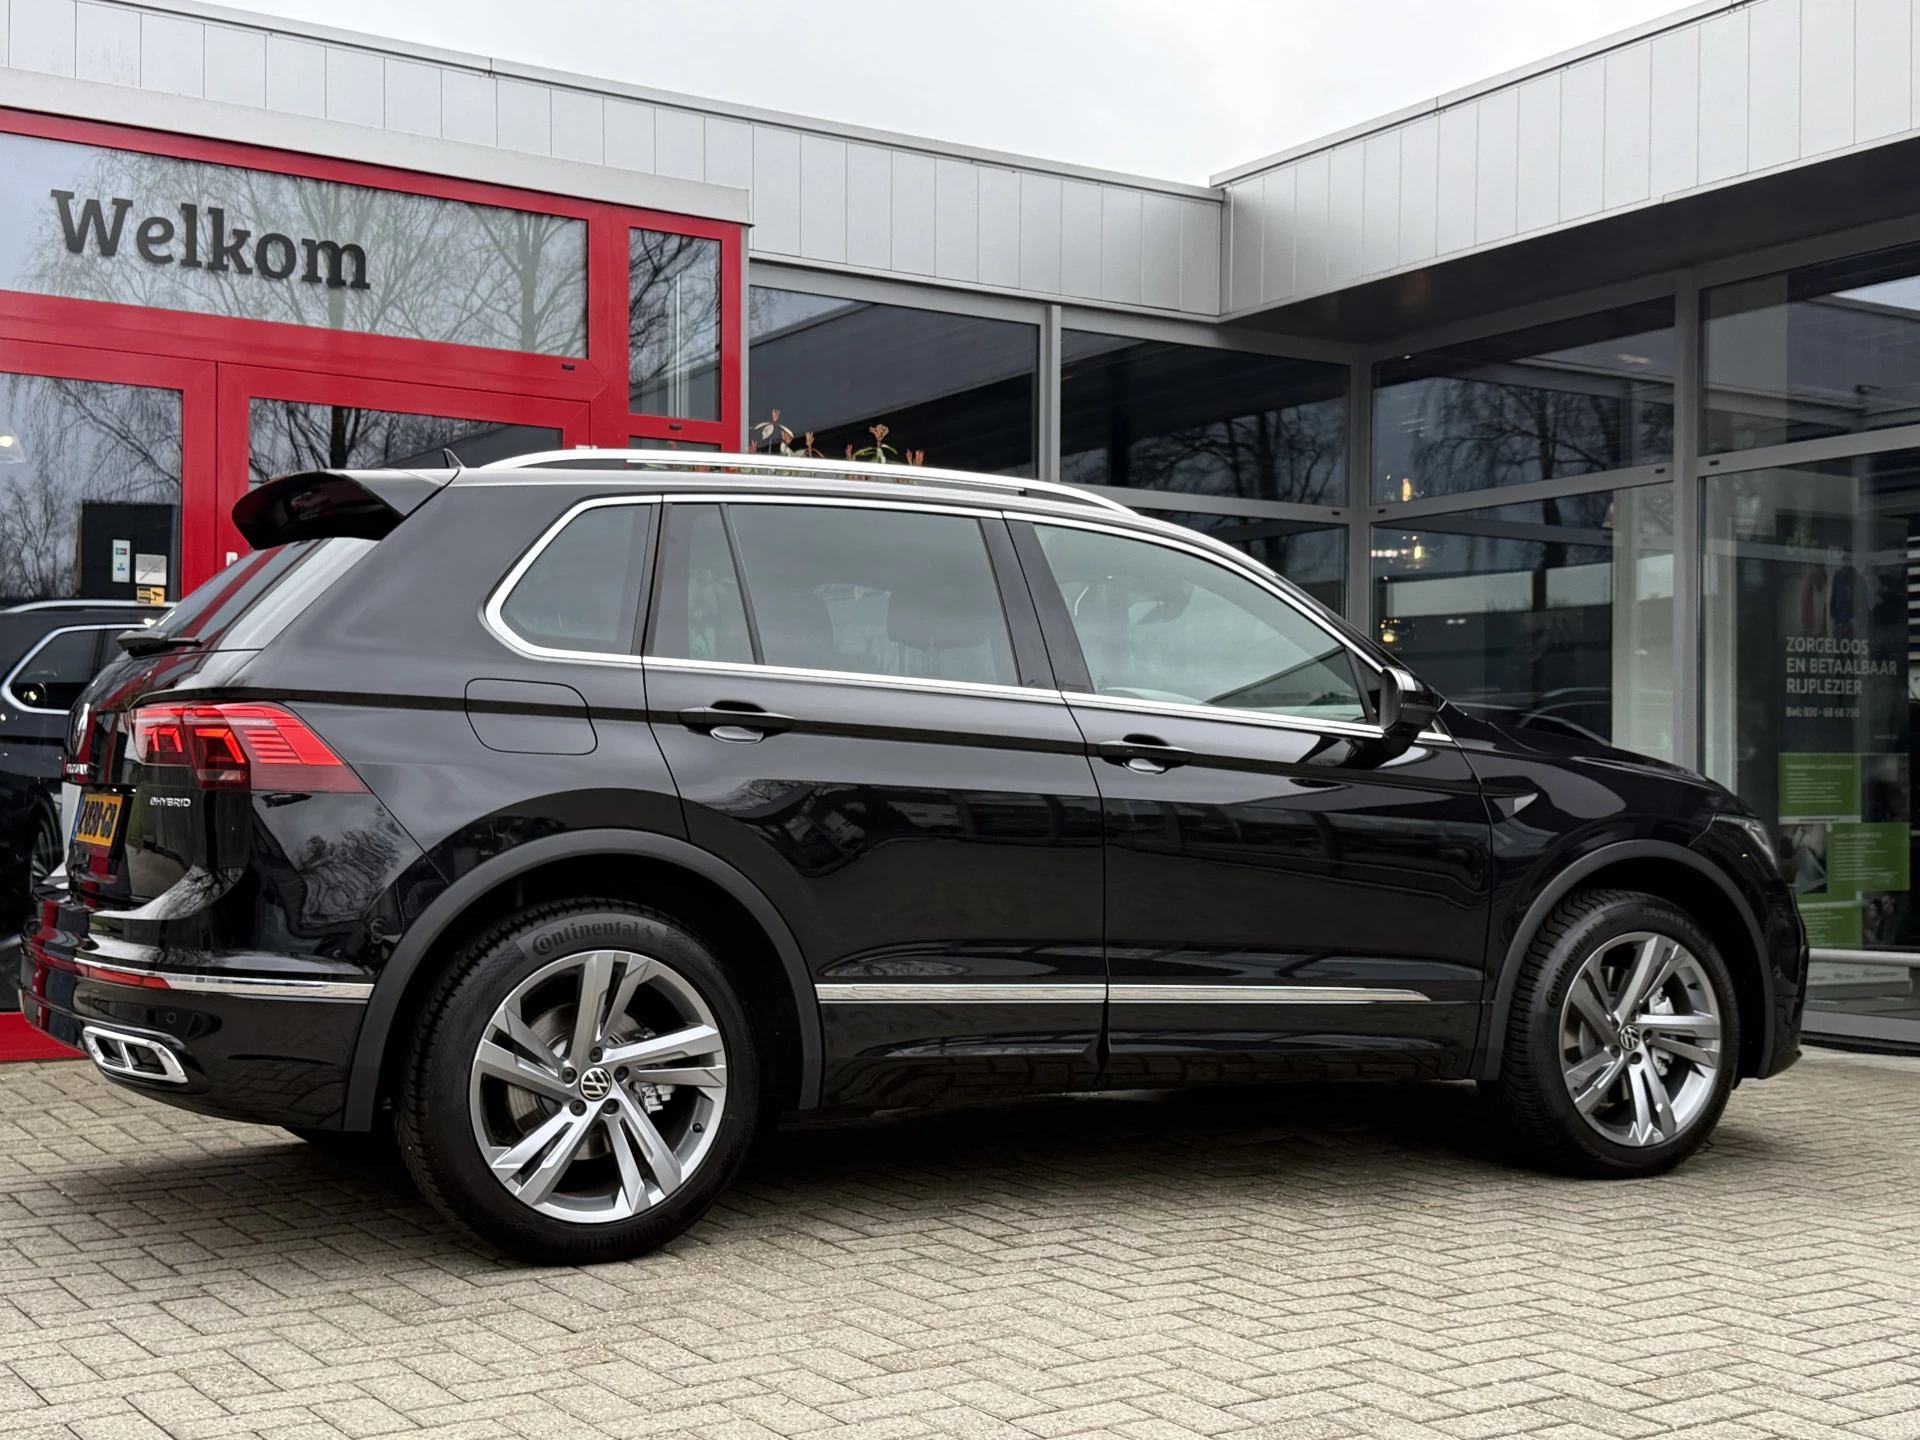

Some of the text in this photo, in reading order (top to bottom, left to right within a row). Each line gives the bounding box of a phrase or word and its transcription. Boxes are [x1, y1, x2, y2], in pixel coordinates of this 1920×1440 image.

[50, 189, 371, 290] Welkom
[1785, 636, 1869, 655] ZORGELOOS
[1786, 658, 1898, 676] EN BETAALBAAR
[1786, 678, 1862, 695] RIJPLEZIER
[531, 920, 640, 956] Continental
[1545, 929, 1594, 1009] Continental
